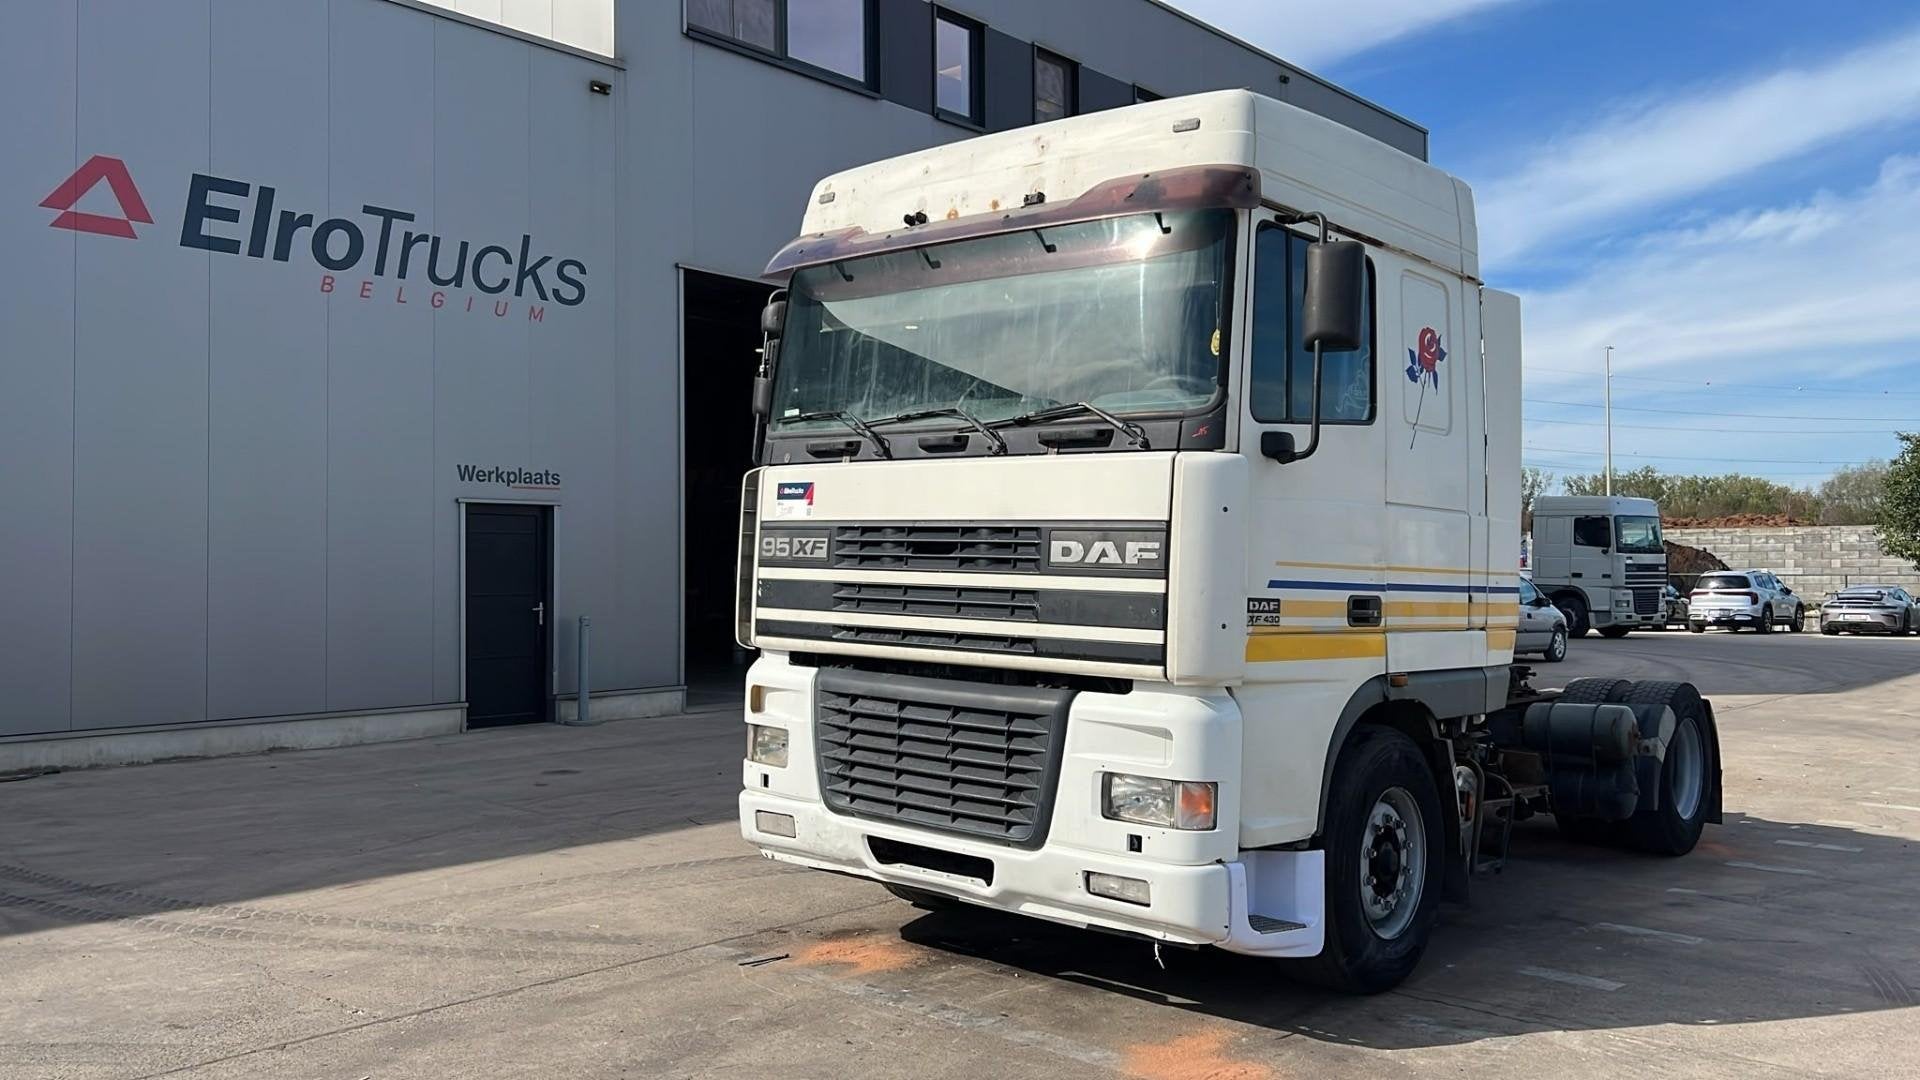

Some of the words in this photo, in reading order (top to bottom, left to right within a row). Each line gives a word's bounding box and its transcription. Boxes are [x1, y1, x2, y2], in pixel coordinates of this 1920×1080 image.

[180, 173, 587, 306] ElroTrucks
[319, 275, 545, 323] BELGIUM
[457, 464, 560, 487] Werkplaats
[1050, 541, 1160, 564] DAF
[1249, 601, 1279, 611] DAF
[1248, 615, 1262, 625] XF
[1263, 615, 1280, 624] 430
